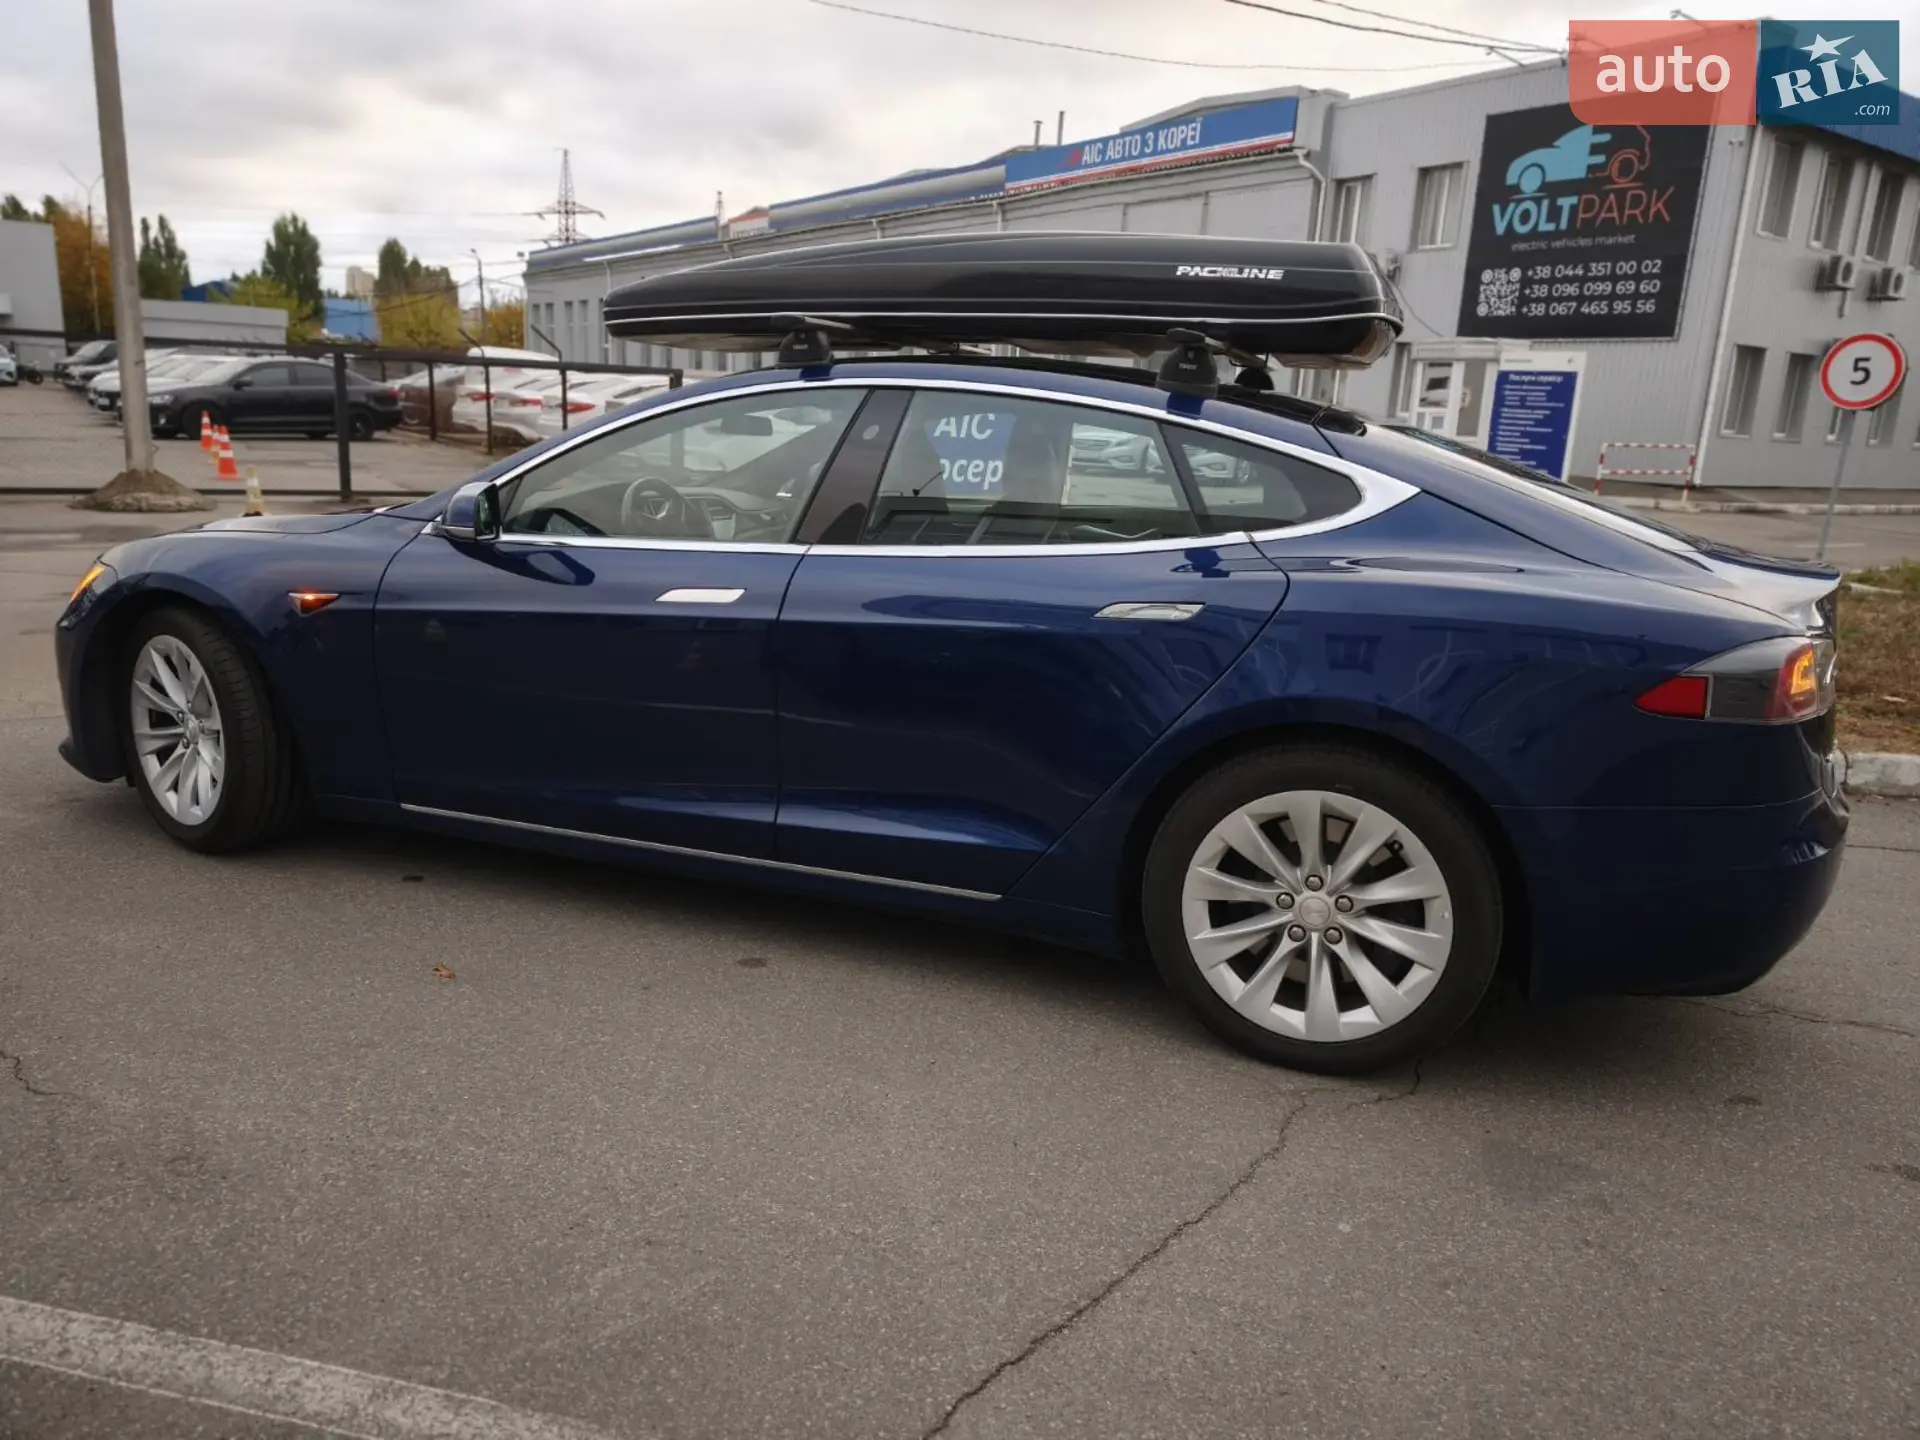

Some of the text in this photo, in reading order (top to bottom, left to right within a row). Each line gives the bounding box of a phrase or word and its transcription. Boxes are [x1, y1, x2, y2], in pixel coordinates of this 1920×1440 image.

[1105, 134, 1141, 161] АВТО
[1158, 117, 1204, 152] КОРЕЇ
[1511, 232, 1637, 252] electric vehicles market
[1526, 259, 1662, 280] +38 044 351 00 02
[1523, 279, 1661, 298] +38 096 099 69 60
[1521, 299, 1657, 317] +38 067 465 95 56
[1849, 356, 1872, 386] 5
